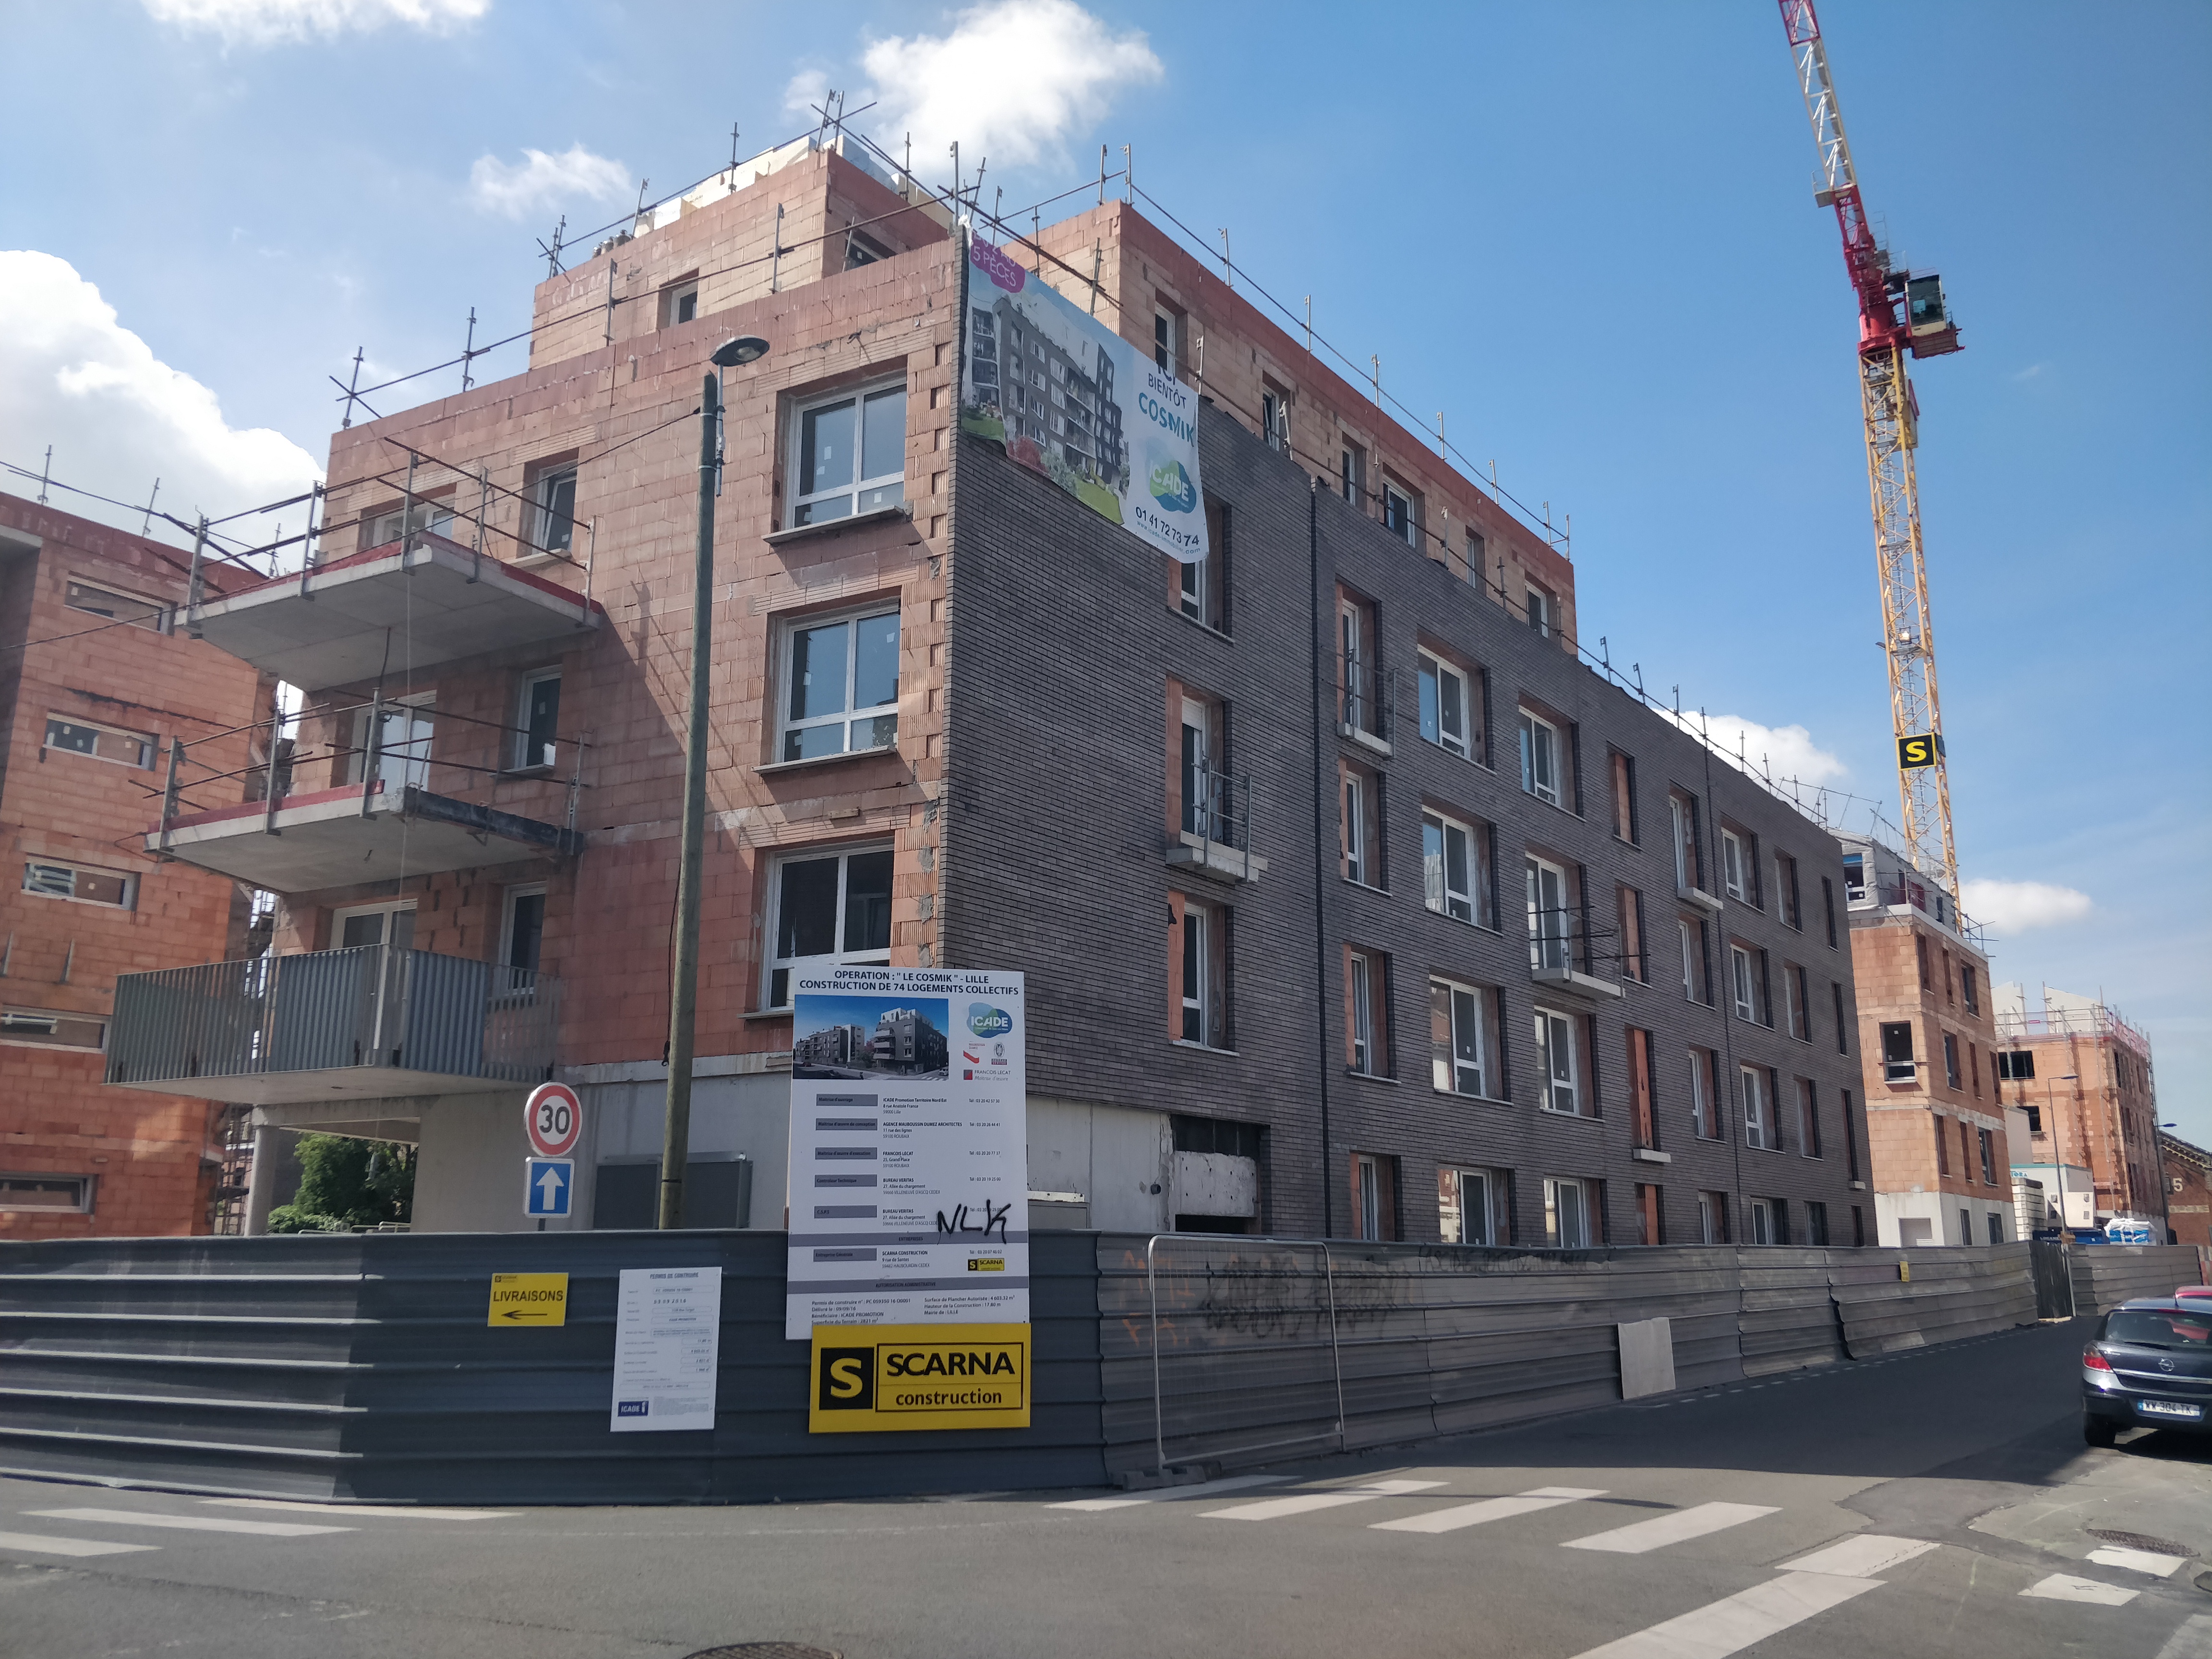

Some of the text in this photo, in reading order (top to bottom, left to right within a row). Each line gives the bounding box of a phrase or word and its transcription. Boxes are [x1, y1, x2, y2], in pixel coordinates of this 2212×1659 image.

[973, 246, 981, 262] 5
[1148, 373, 1187, 409] BIENTÔT
[1138, 392, 1194, 447] COSMIK
[1136, 506, 1200, 547] 01 41 72 73 74
[1906, 741, 1927, 762] S
[834, 970, 989, 984] OPERATION LE COSMIK LILLE
[799, 980, 1019, 995] CONSTRUCTION DE 74 LOGEMENTS COLLECTIFS
[971, 1015, 1009, 1027] ICADE
[539, 1104, 570, 1135] 30
[2173, 1178, 2183, 1192] 5
[970, 1261, 976, 1269] S
[493, 1289, 564, 1302] LIVRAISONS
[830, 1351, 1016, 1398] S SCARNA
[896, 1387, 1002, 1406] construction
